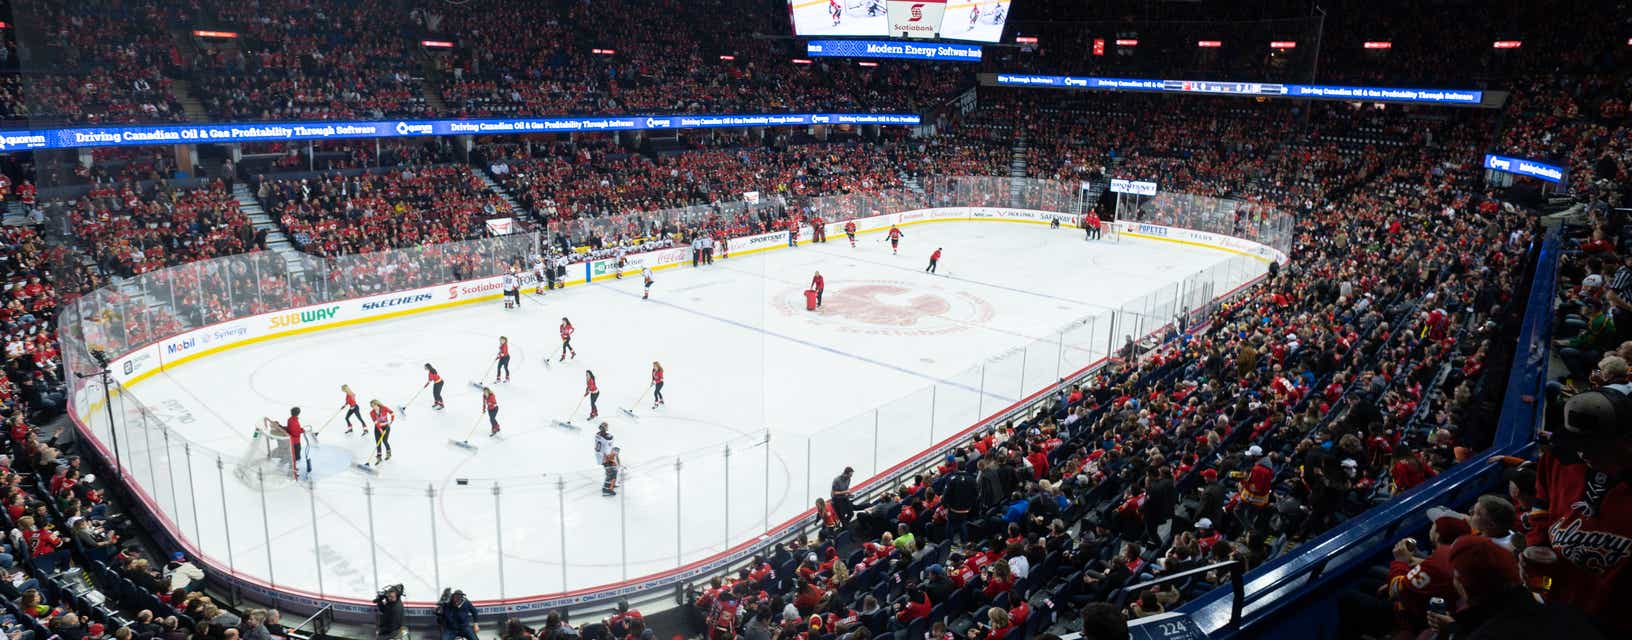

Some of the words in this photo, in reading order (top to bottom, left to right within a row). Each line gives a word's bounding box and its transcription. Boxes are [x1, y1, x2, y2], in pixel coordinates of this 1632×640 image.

[894, 24, 934, 32] Scotiabank
[867, 44, 903, 54] Modern
[905, 46, 937, 57] Energy
[1301, 87, 1323, 96] Driving
[1323, 87, 1351, 97] Canadian
[1352, 88, 1362, 96] Oil
[1368, 90, 1380, 98] Gas
[1381, 90, 1418, 100] Profitability
[1418, 91, 1445, 101] Through
[1445, 92, 1473, 101] Software
[450, 122, 479, 132] Driving
[480, 121, 513, 131] Canadian
[514, 121, 524, 130] Oil
[531, 121, 544, 129] Gas
[544, 120, 582, 130] Profitability
[582, 119, 608, 129] Through
[608, 119, 634, 128] Software
[681, 118, 700, 127] Driving
[7, 135, 45, 147] quorum
[75, 131, 121, 143] Driving
[123, 129, 179, 142] Canadian
[181, 129, 198, 139] Oil
[200, 130, 208, 138] &
[209, 129, 229, 138] Gas
[231, 126, 292, 138] Profitability
[293, 125, 335, 137] Through
[336, 125, 376, 135] Software
[462, 281, 504, 296] Scotiaba
[361, 292, 432, 311] SKECHERS
[268, 305, 340, 330] SUBWAY
[214, 327, 248, 341] Synergy
[167, 338, 196, 355] Mobil
[1159, 622, 1187, 636] 224
